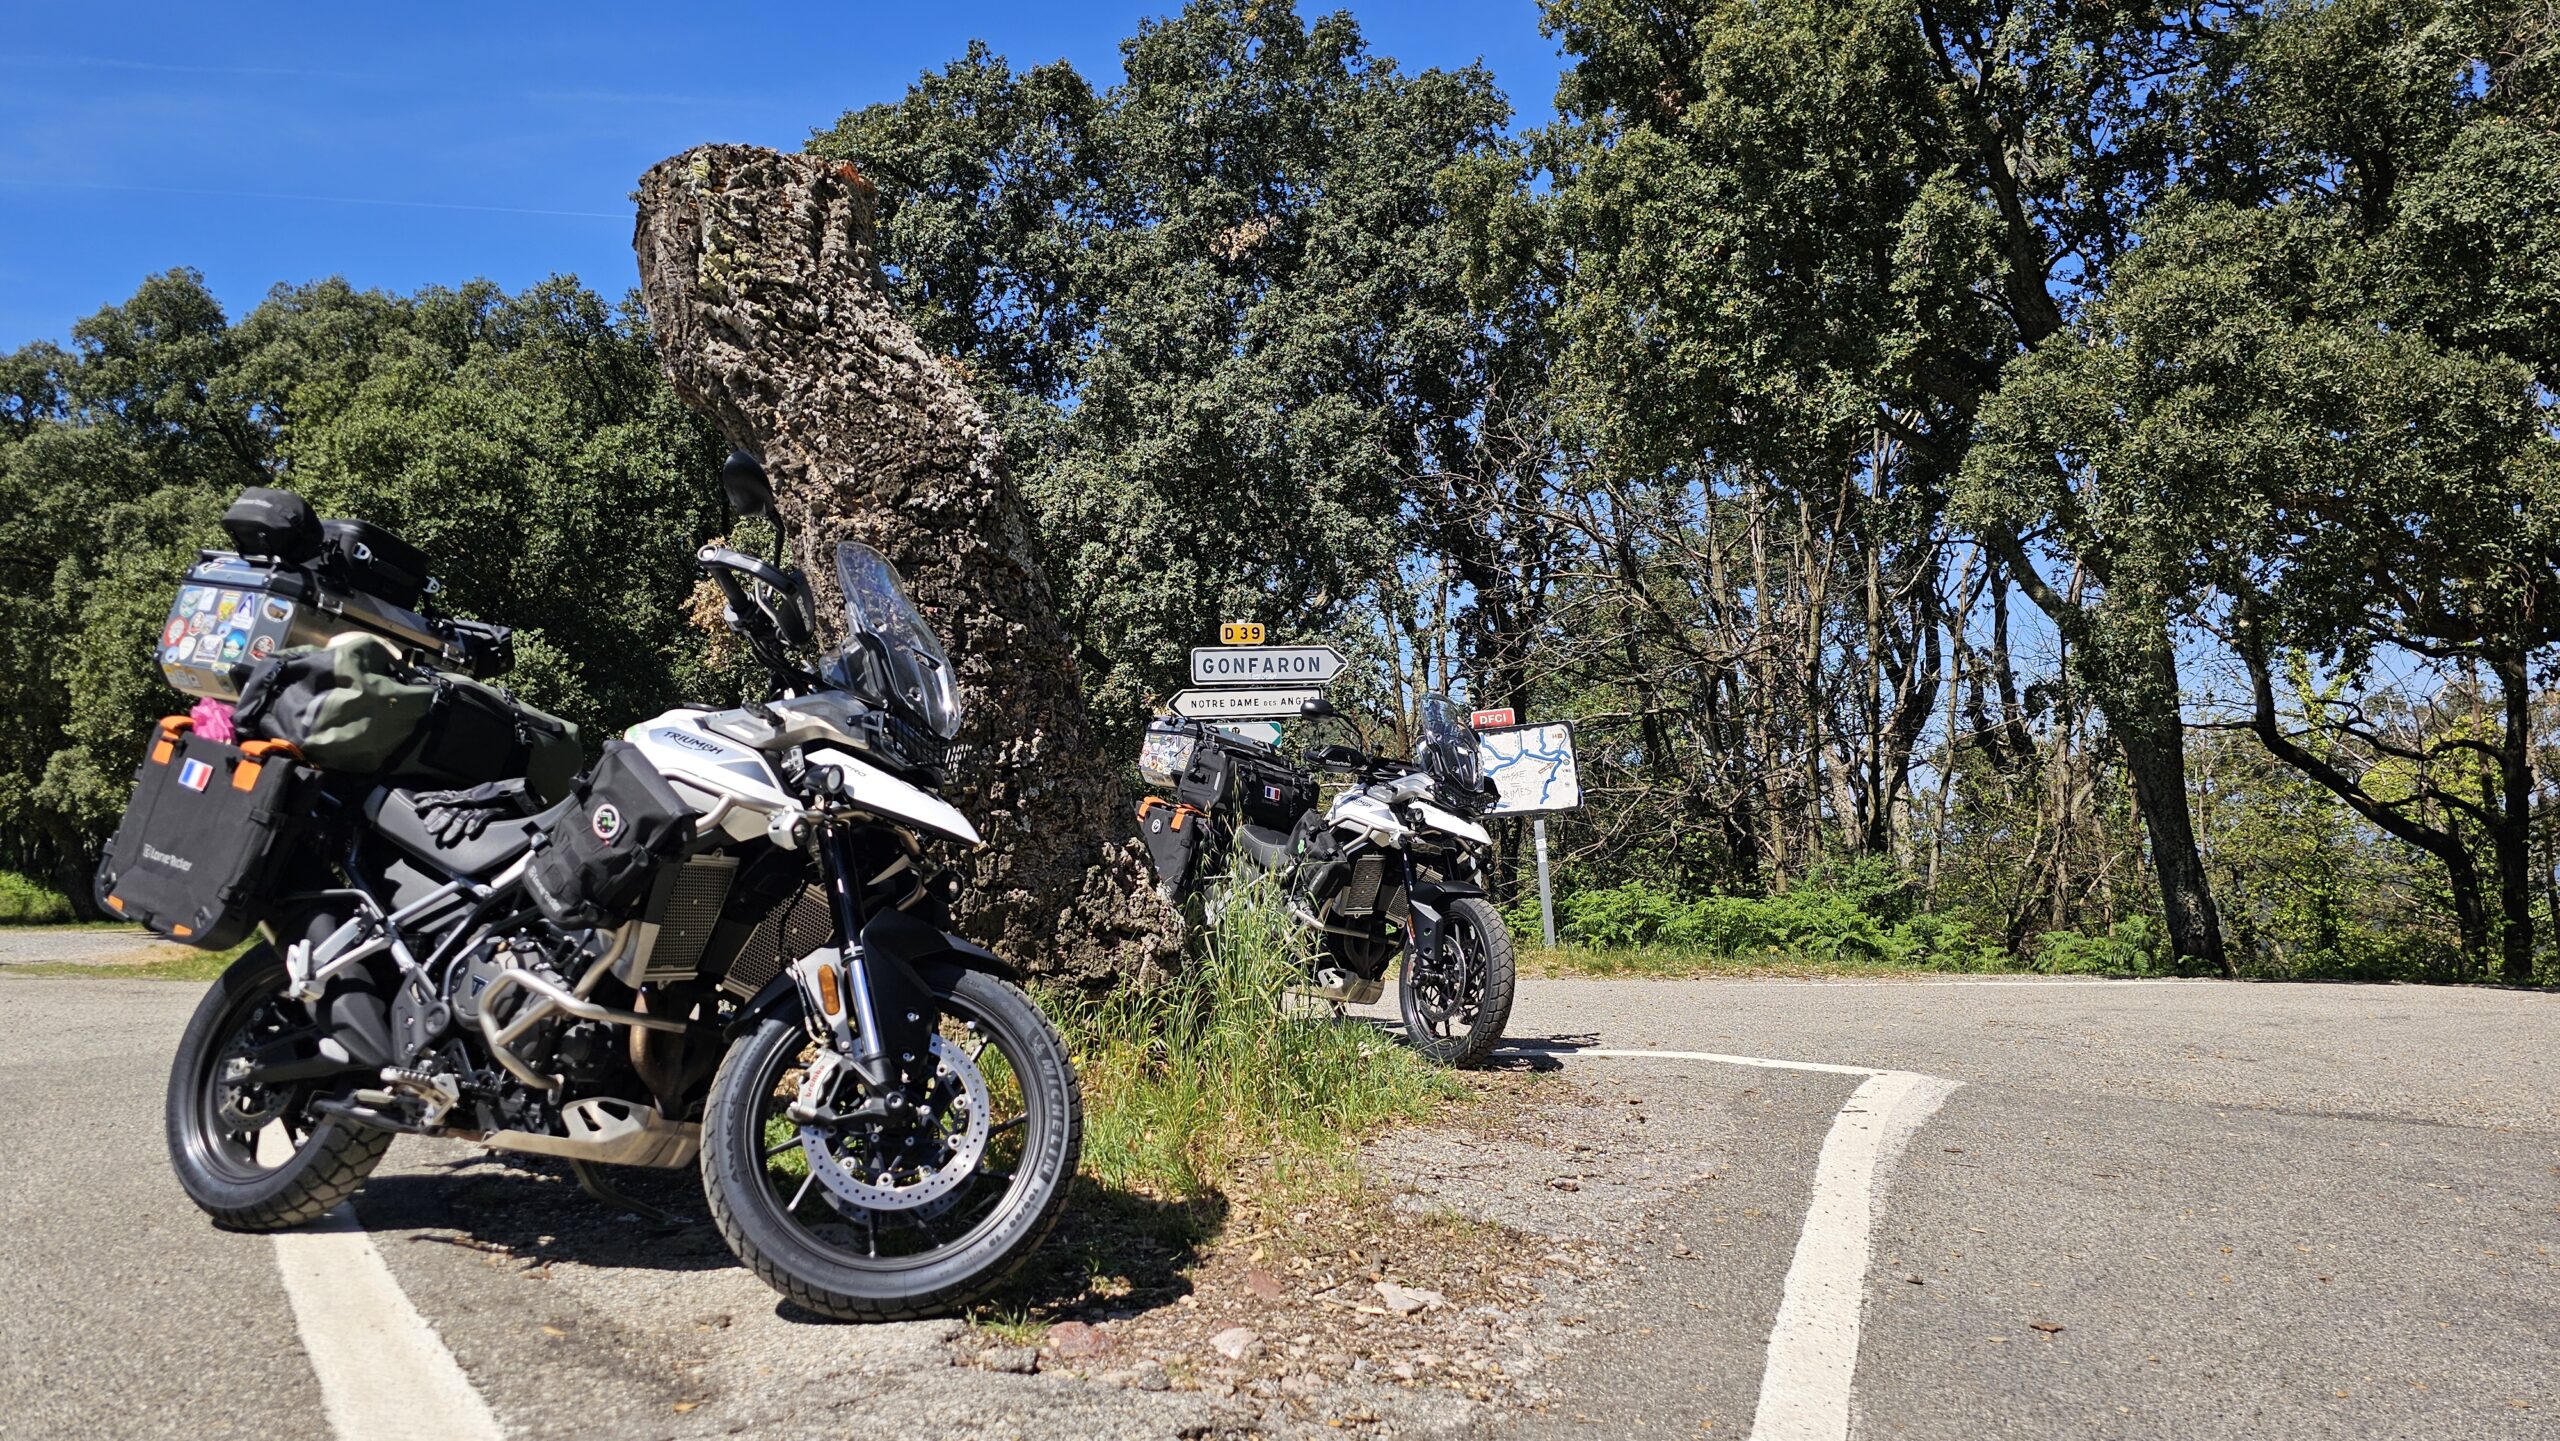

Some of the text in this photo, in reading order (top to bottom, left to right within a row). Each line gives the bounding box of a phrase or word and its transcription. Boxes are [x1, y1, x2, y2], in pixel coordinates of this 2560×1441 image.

[1225, 627, 1260, 640] D 39
[1202, 656, 1320, 674] GONFARON
[1191, 699, 1225, 709] NOTRE
[1230, 698, 1260, 707] DAME
[1479, 713, 1507, 725] DFCI
[663, 731, 724, 756] TRIUMPH
[843, 763, 867, 777] PRO
[805, 1065, 825, 1098] brembo
[1041, 1058, 1064, 1179] MICHELIN
[726, 1092, 740, 1184] ANAKEE
